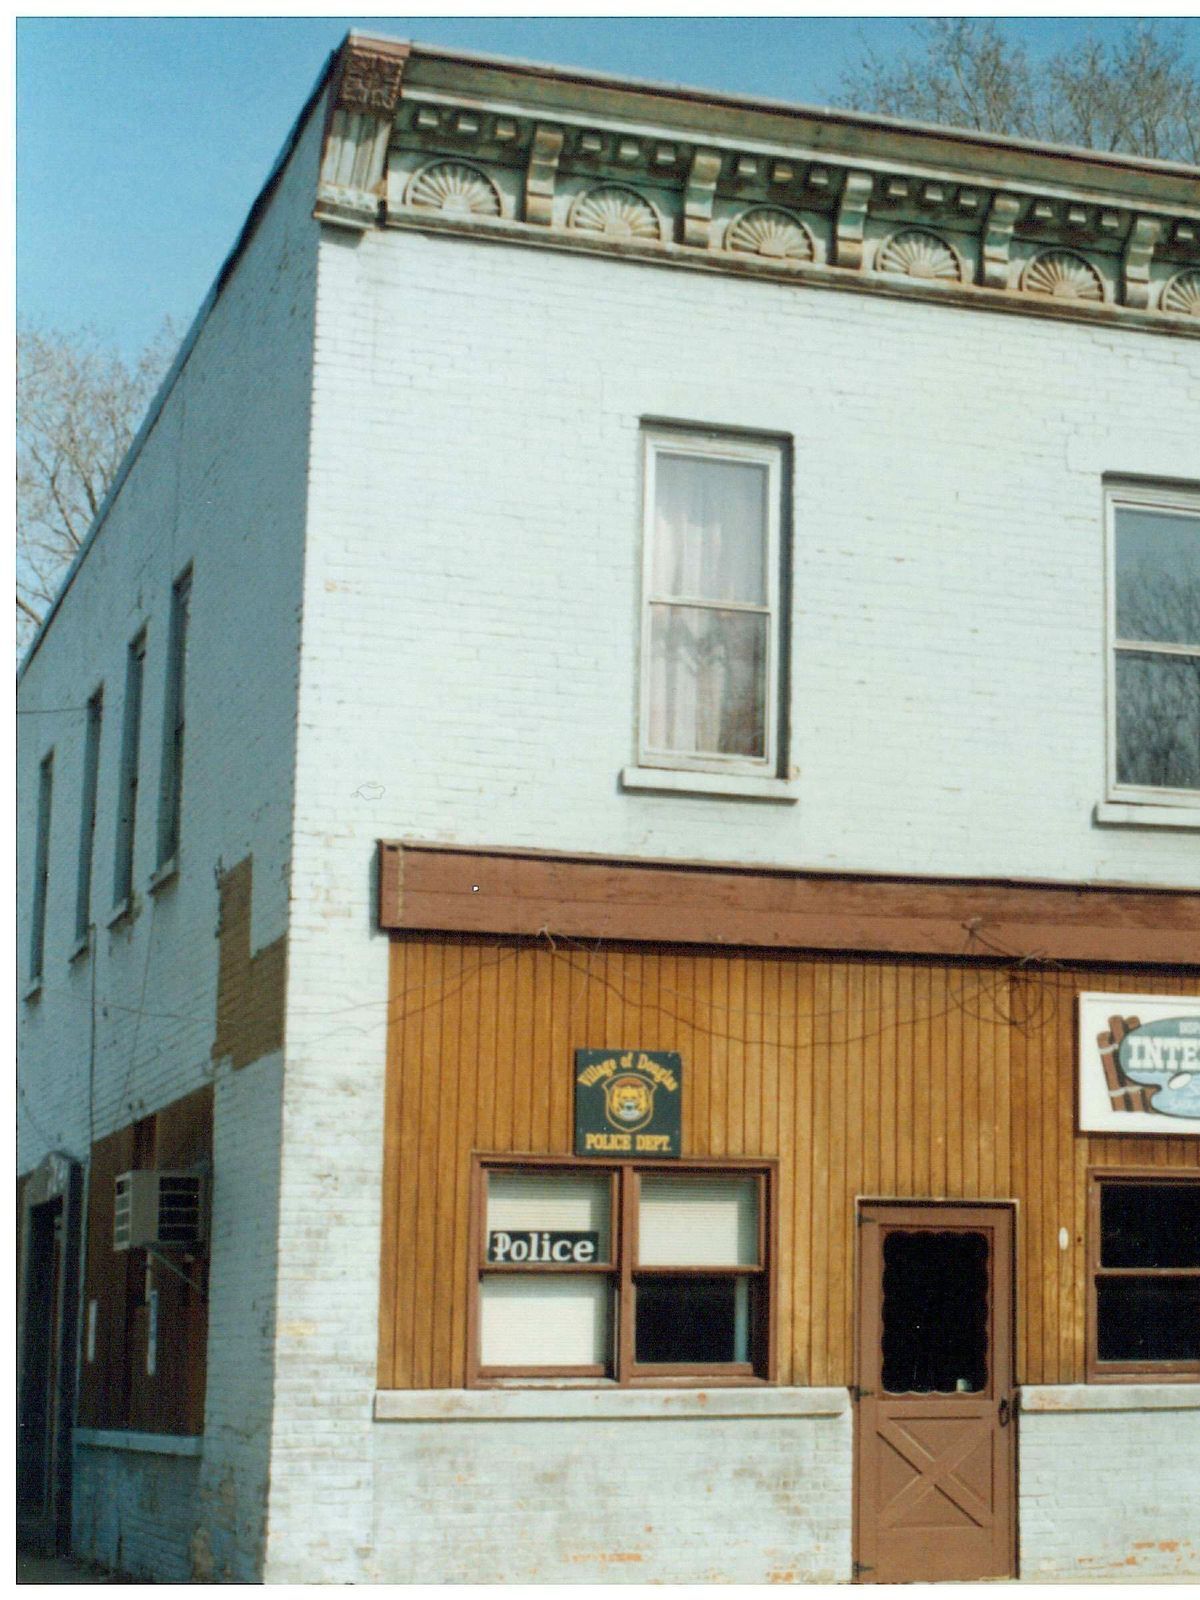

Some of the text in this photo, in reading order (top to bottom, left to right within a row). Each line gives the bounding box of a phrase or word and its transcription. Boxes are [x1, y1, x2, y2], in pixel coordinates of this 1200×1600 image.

[620, 1051, 634, 1069] of
[585, 1133, 631, 1151] POLICE
[492, 1232, 595, 1262] Police
